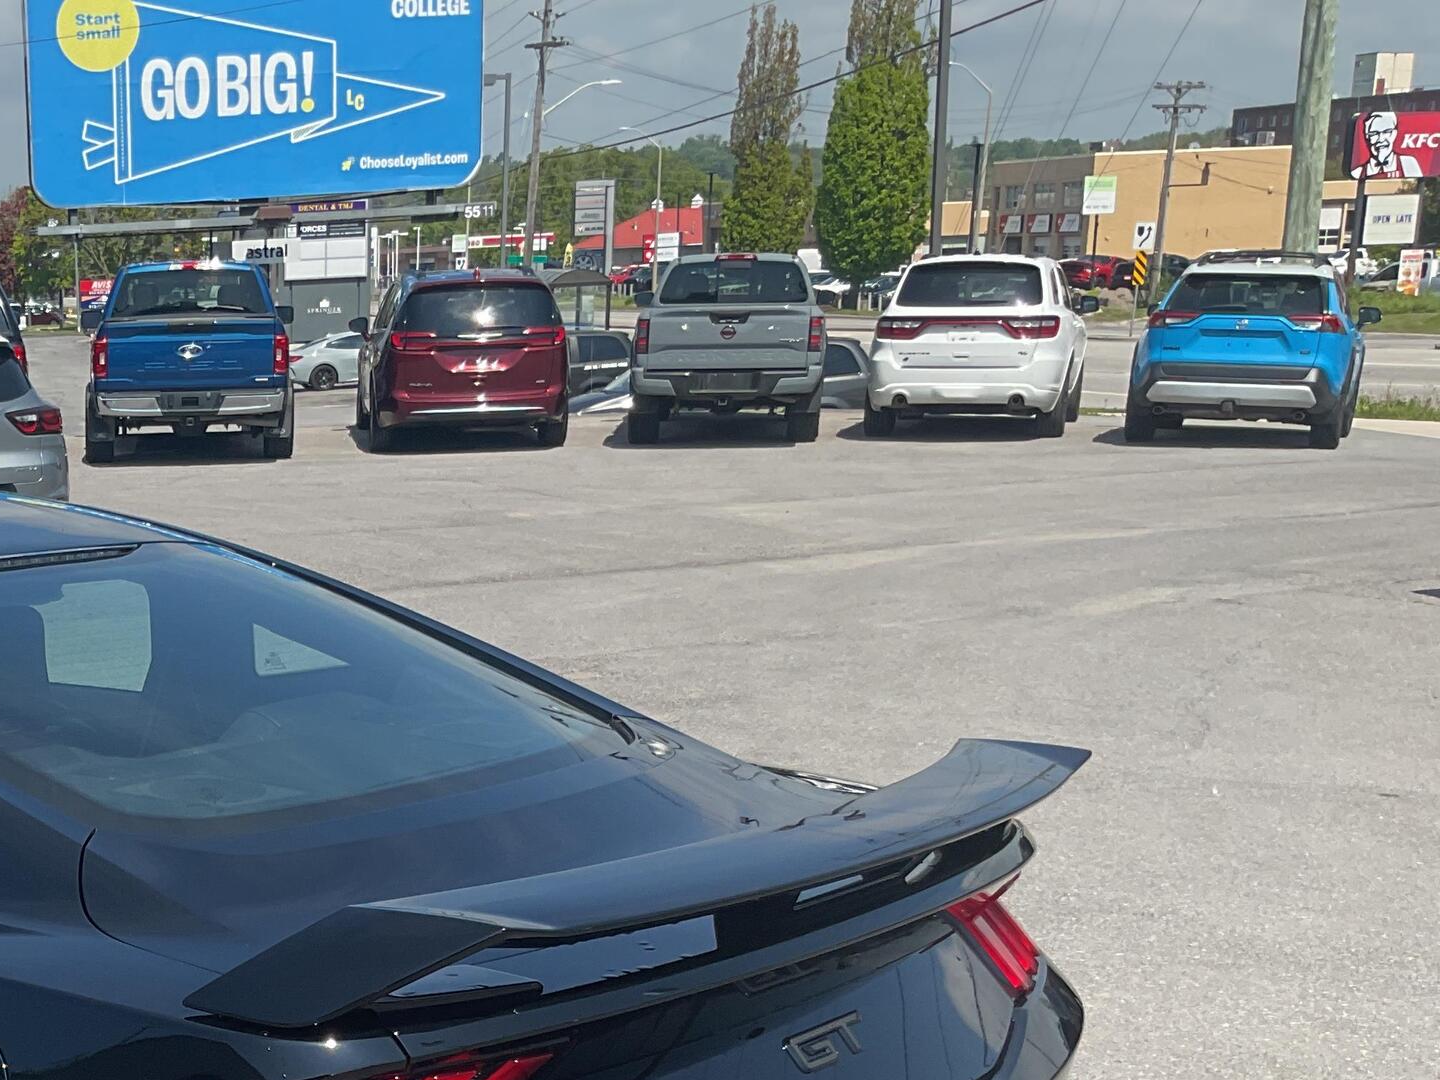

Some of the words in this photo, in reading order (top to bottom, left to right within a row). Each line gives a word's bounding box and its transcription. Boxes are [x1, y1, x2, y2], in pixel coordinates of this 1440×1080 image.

[391, 0, 470, 18] COLLEGE
[75, 13, 120, 26] Start
[76, 26, 120, 40] small
[141, 57, 210, 121] GO
[216, 51, 315, 117] BIG!
[1400, 133, 1440, 149] KFC
[360, 152, 468, 170] ChooseLoyalist.com
[298, 203, 329, 212] DENTAL
[330, 202, 337, 210] &
[339, 202, 353, 210] TMJ
[1372, 215, 1391, 224] OPEN
[1395, 214, 1412, 223] LATE
[246, 243, 288, 259] astral
[91, 280, 112, 289] AVIS
[782, 1009, 862, 1074] GT
